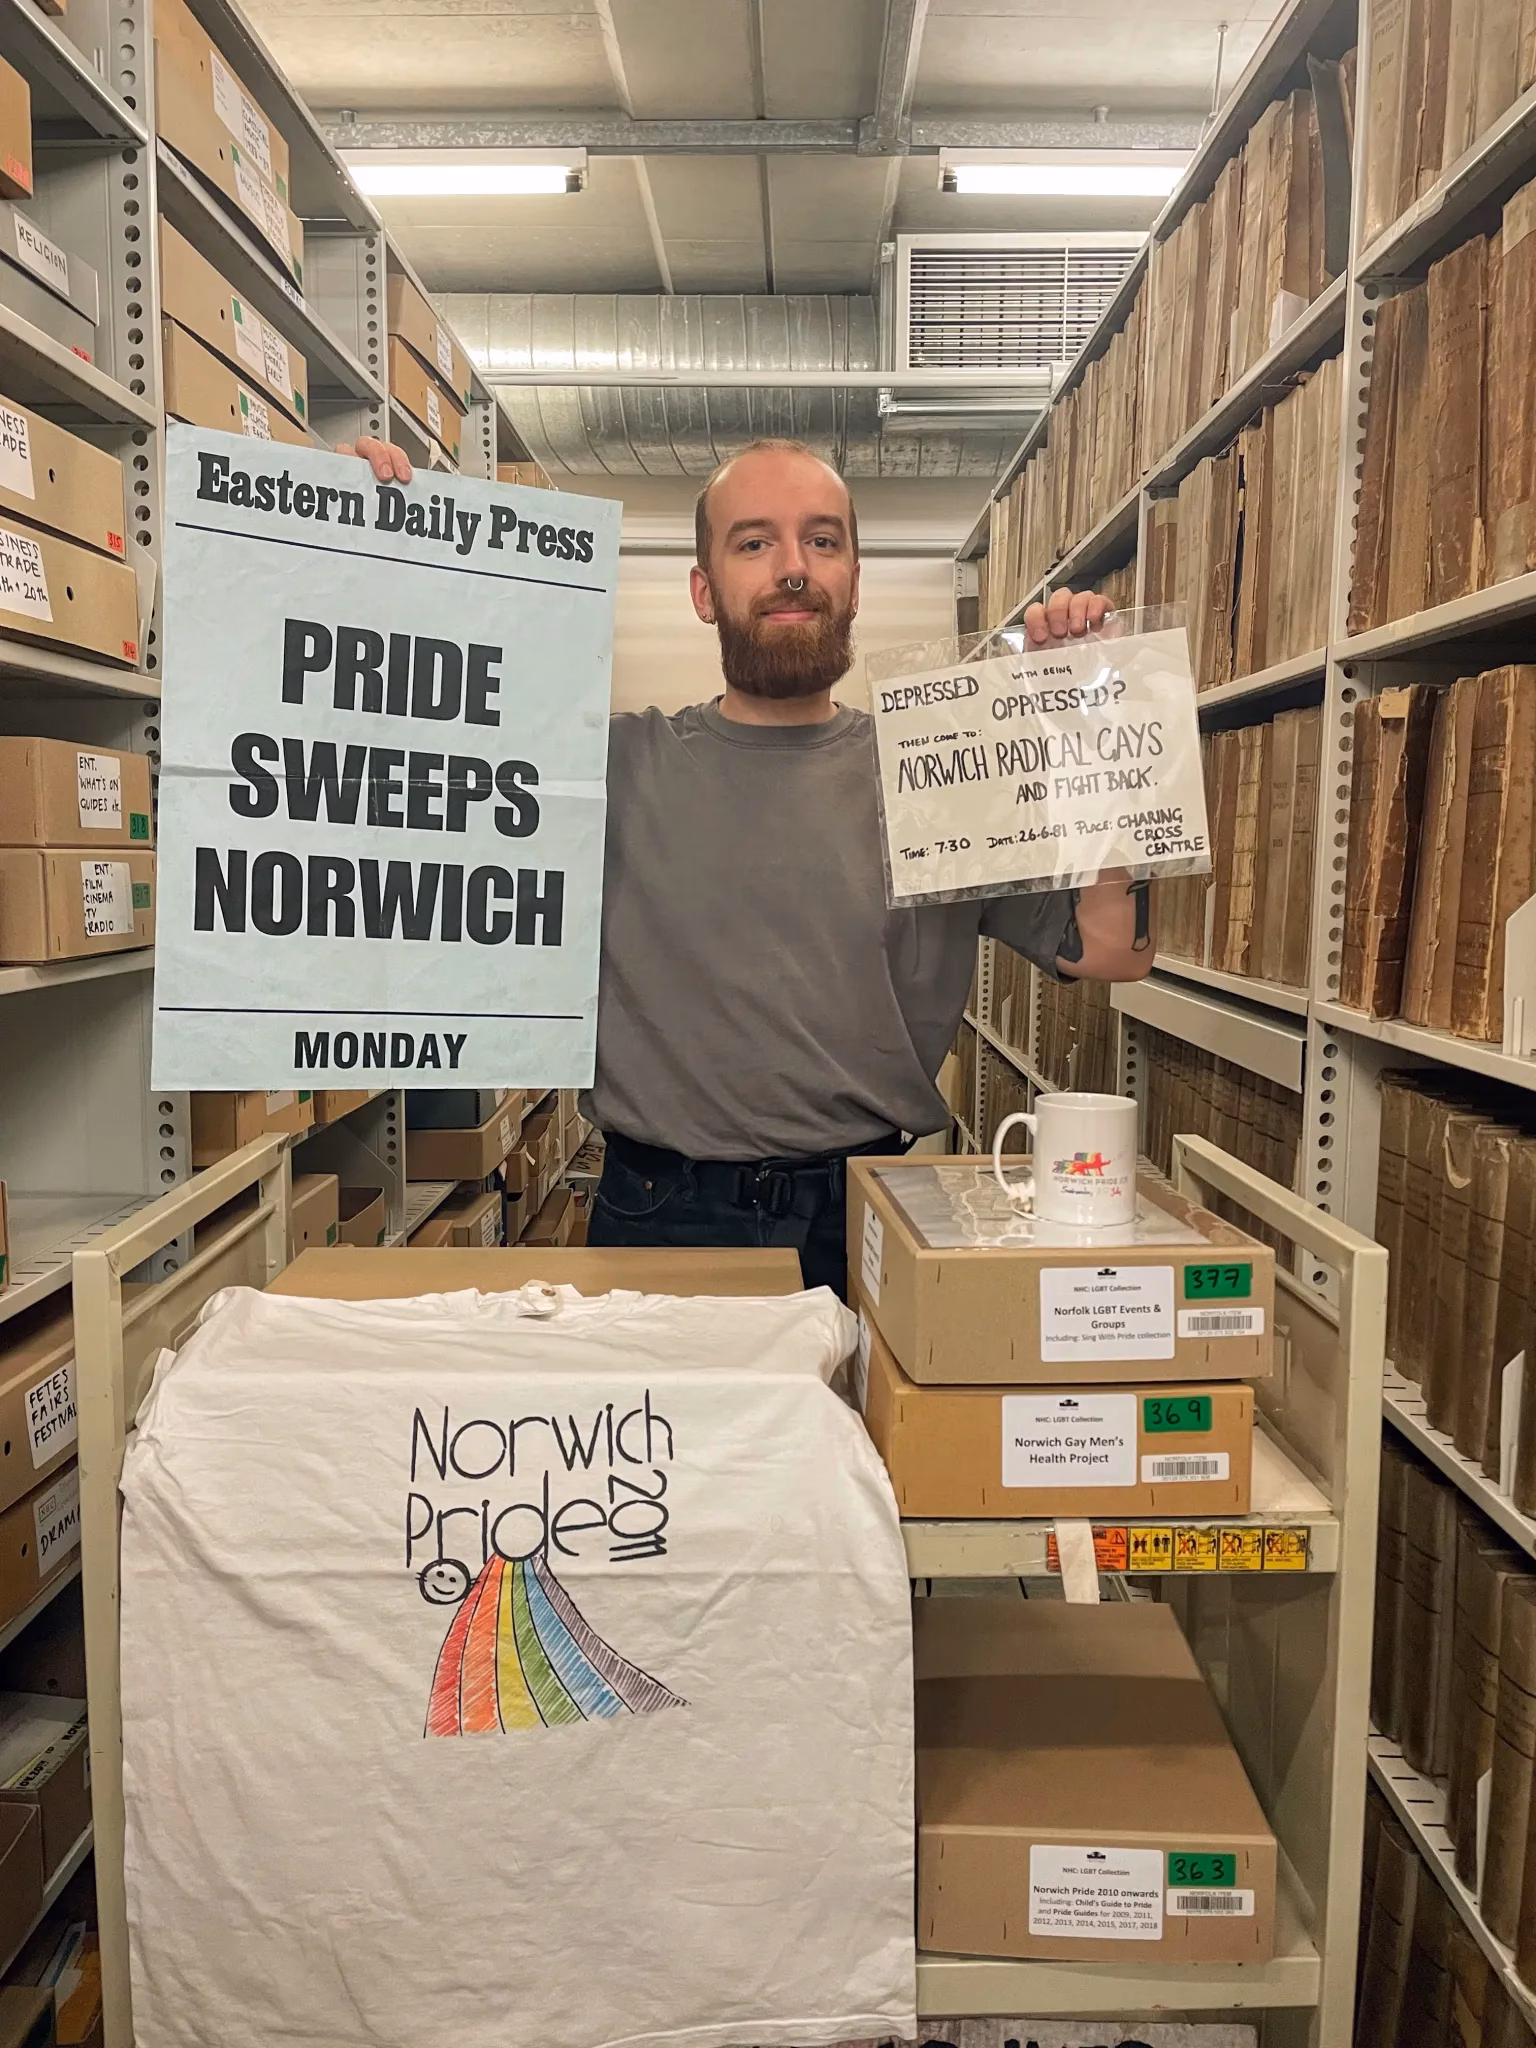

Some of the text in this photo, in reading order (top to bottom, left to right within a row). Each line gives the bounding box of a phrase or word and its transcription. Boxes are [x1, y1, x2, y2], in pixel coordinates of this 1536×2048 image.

[17, 223, 67, 276] RELIGION
[0, 432, 27, 459] ADE
[197, 452, 594, 563] Eastern Daily Press
[23, 582, 48, 602] 20th
[281, 618, 503, 727] PRIDE
[1044, 665, 1073, 677] BEING
[881, 675, 1126, 721] DEPRESSED OPPRESSED?
[898, 730, 983, 749] THEN COME TO:
[79, 756, 97, 771] ENT.
[898, 721, 1163, 793] NORWICH RADICAL GAYS
[229, 733, 539, 837] SWEEPS
[1016, 766, 1158, 805] AND FIGHT BACK.
[80, 798, 108, 812] GUIDES
[900, 847, 929, 861] TIME:
[935, 838, 971, 854] 7.30
[1075, 820, 1112, 835] PLACE:
[1117, 808, 1183, 829] CHARING
[1134, 825, 1183, 841] CROSS
[1145, 836, 1205, 857] CENTRE
[85, 891, 114, 904] CINEMA
[194, 847, 565, 947] NORWICH
[88, 920, 114, 934] RADIO
[294, 1031, 467, 1069] MONDAY
[1192, 1268, 1240, 1289] 377
[1054, 1304, 1162, 1316] Norfolk LGBT Events &
[1091, 1320, 1126, 1330] Groups
[1082, 1334, 1097, 1342] Sing
[1137, 1331, 1171, 1339] collection
[29, 1369, 68, 1408] FETES
[31, 1386, 69, 1426] FAIRS
[1151, 1400, 1201, 1425] 369
[411, 1389, 674, 1482] Norwich
[1015, 1436, 1124, 1449] Norwich Gay Men’s
[1029, 1453, 1109, 1465] Health Project
[405, 1470, 607, 1568] Pride
[1174, 1859, 1225, 1881] 363
[1033, 1885, 1159, 1898] Norwich Pride 2010 onwards
[1053, 1908, 1072, 1916] Pride
[1073, 1909, 1098, 1917] Guides
[1100, 1910, 1110, 1918] for
[1075, 1899, 1099, 1907] Child's
[1100, 1900, 1122, 1908] Guide
[1133, 1901, 1152, 1909] Pride
[1140, 1921, 1158, 1929] 2018
